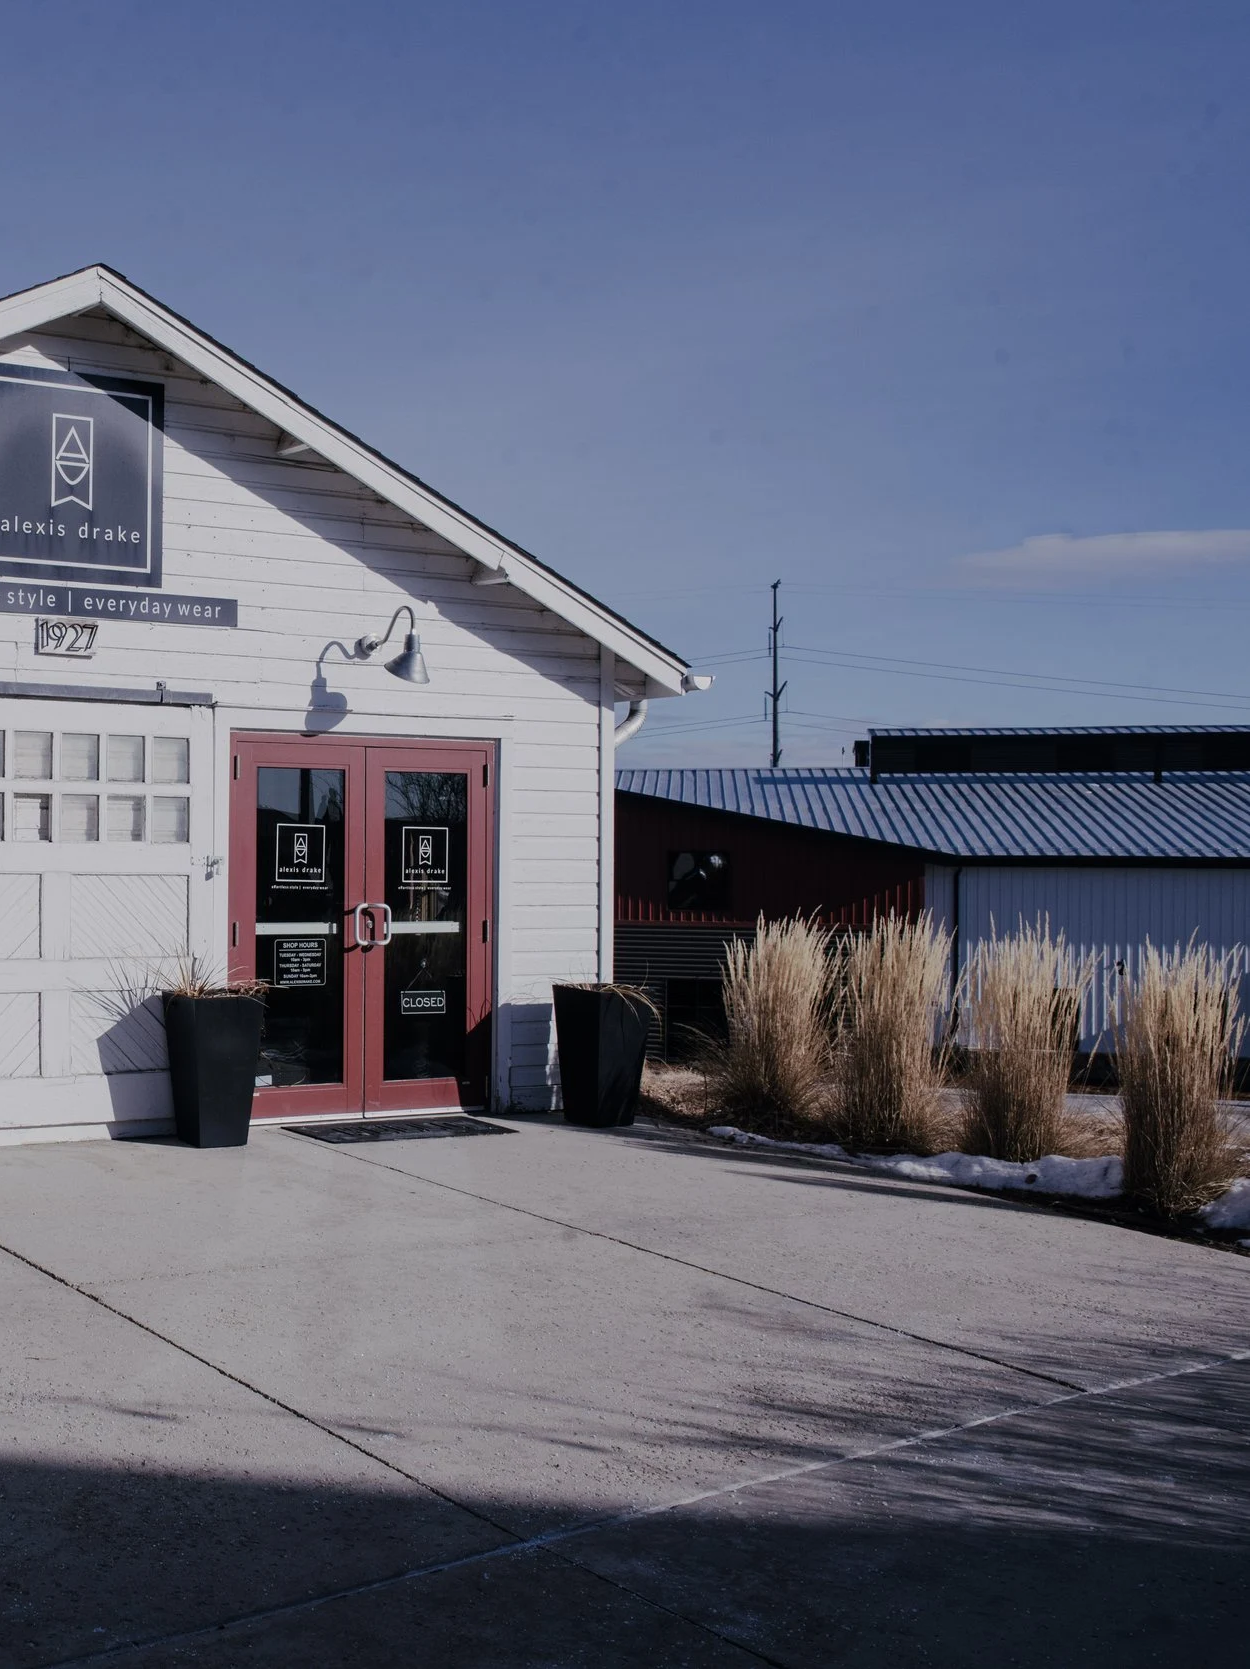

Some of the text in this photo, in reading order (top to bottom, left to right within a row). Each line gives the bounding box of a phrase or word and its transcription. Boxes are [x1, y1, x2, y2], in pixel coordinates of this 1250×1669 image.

[0, 516, 140, 544] alexis drake
[8, 588, 56, 608] style
[84, 594, 172, 617] everyday
[178, 604, 221, 619] wear
[39, 621, 99, 652] 1927
[403, 998, 444, 1007] CLOSED
